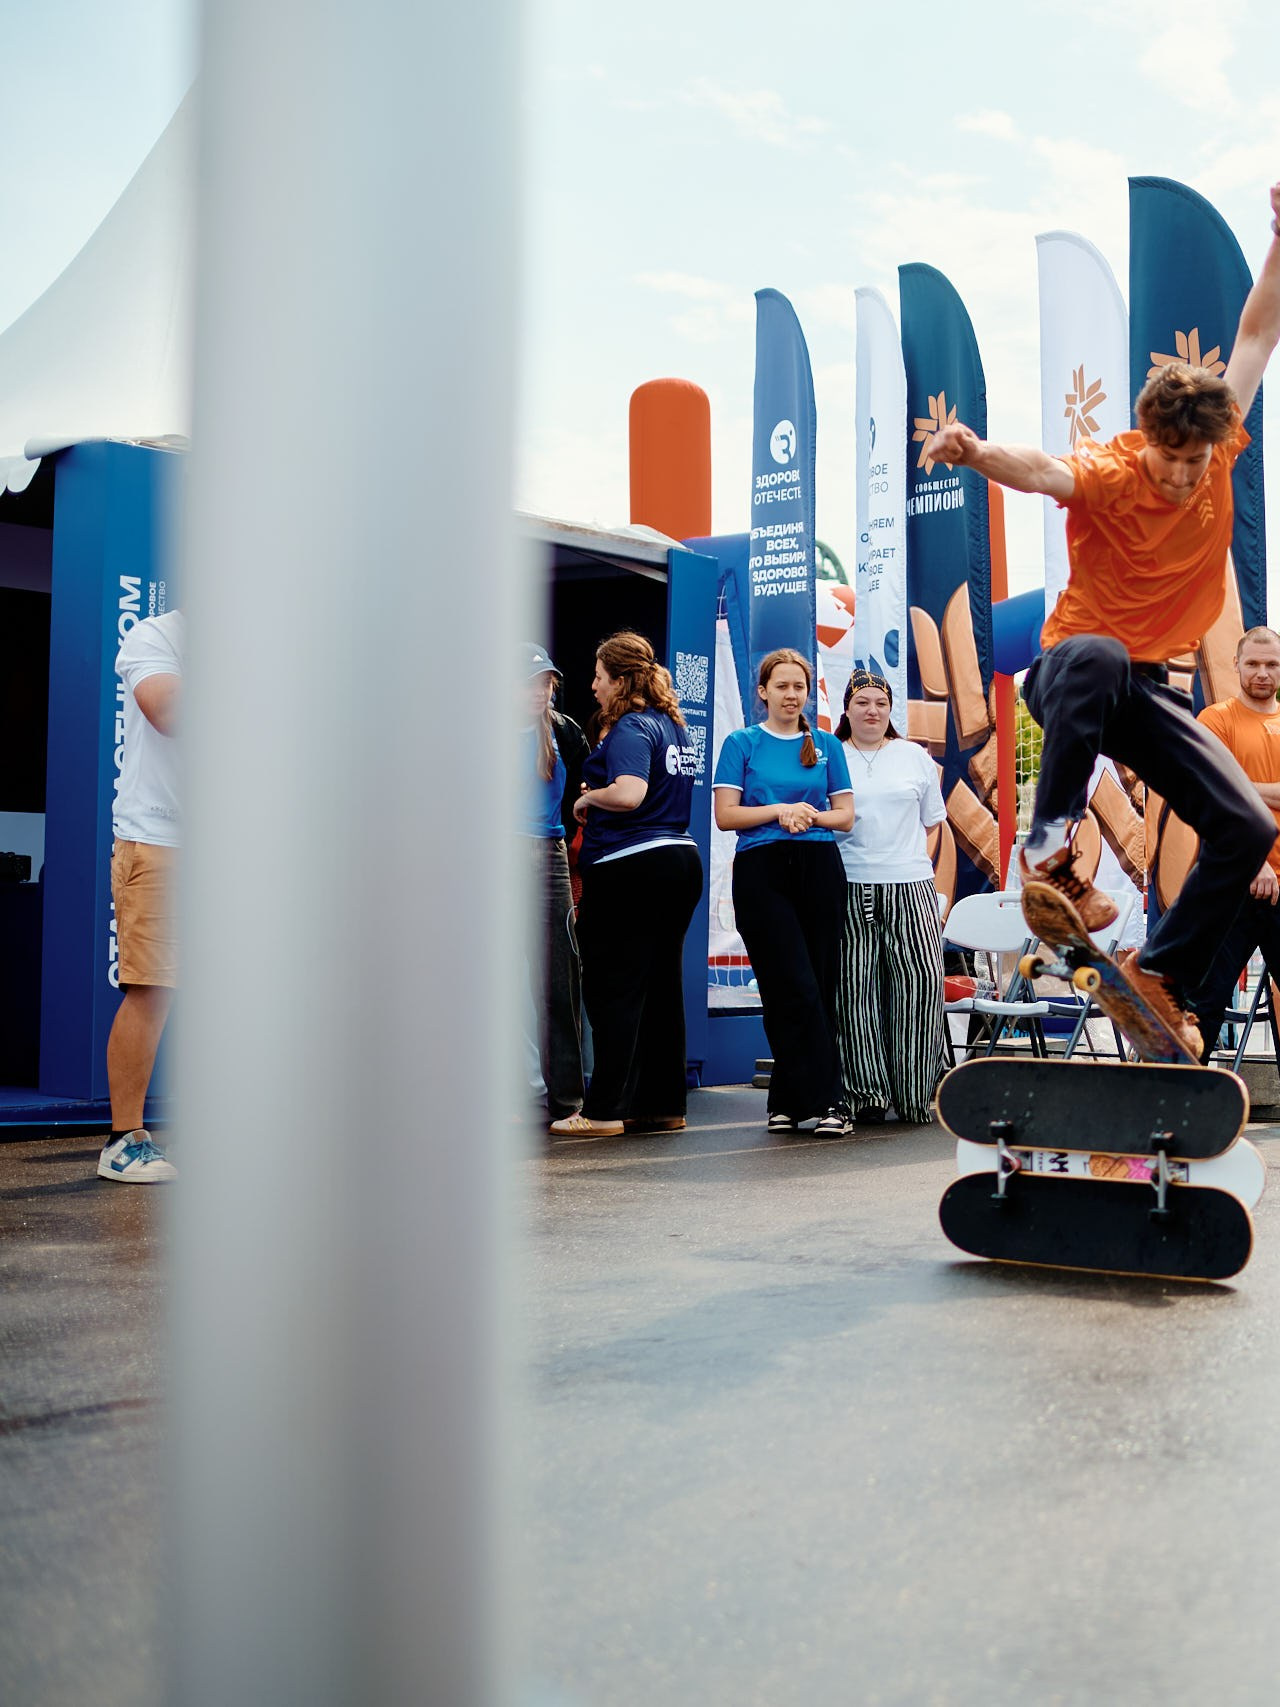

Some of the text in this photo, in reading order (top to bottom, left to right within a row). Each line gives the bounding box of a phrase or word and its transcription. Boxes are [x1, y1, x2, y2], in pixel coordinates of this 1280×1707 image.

[915, 477, 960, 494] СООБЩЕСТВО
[766, 537, 799, 551] ВСЕХ,
[754, 580, 807, 597] БУДУЩЕЕ
